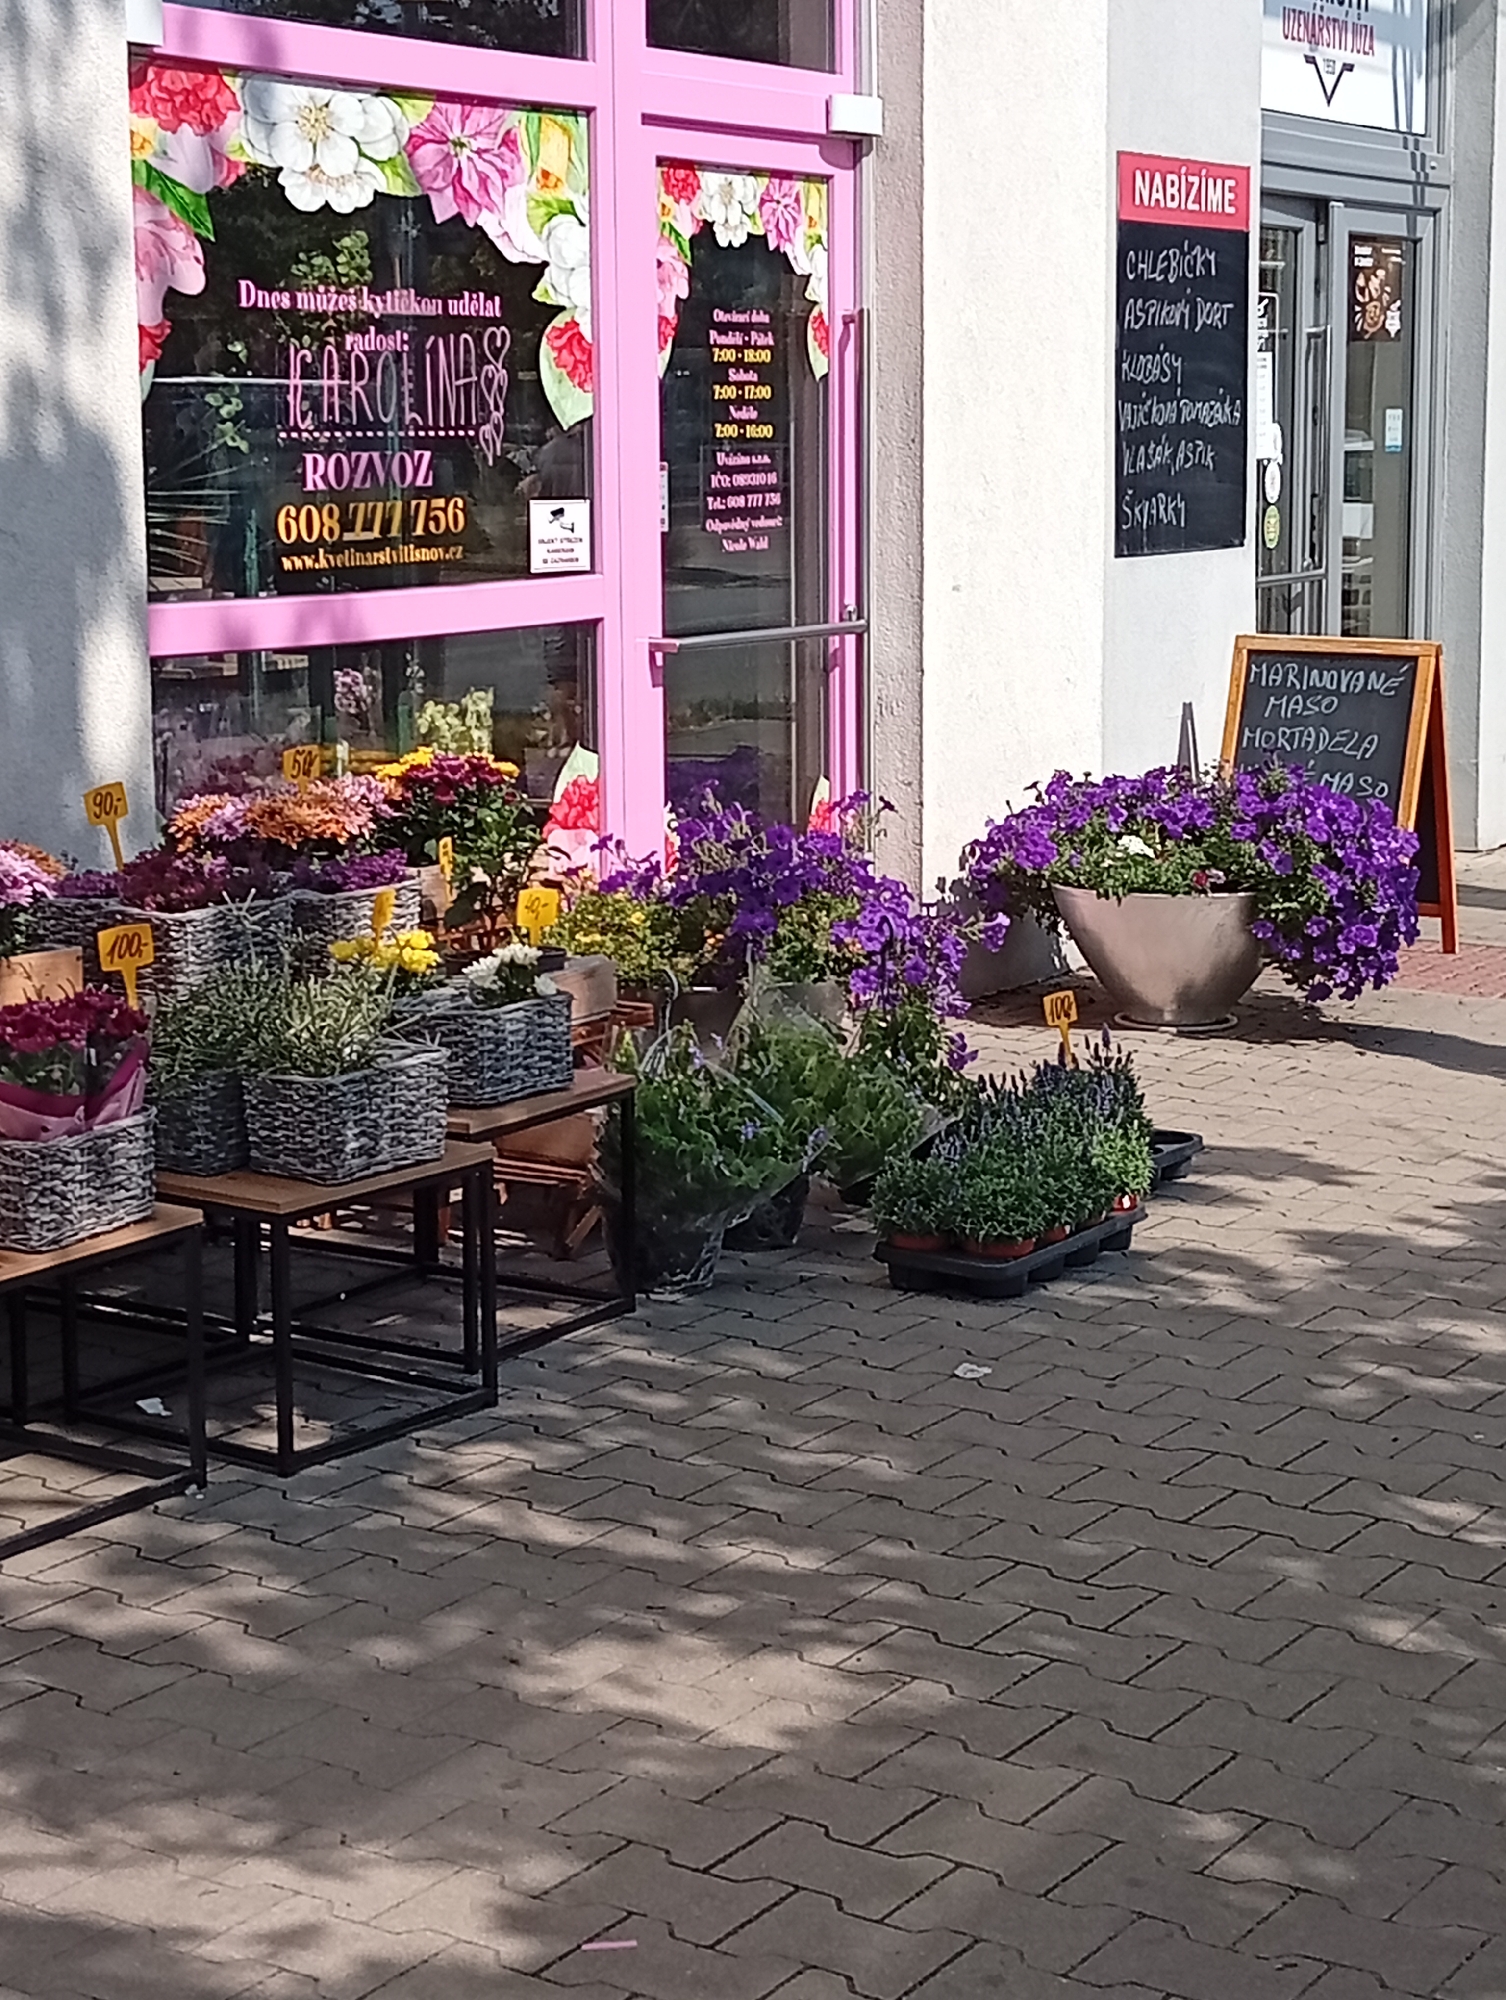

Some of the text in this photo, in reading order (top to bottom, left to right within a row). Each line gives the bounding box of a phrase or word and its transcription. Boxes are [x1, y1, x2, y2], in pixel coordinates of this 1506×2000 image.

[1135, 156, 1236, 214] NABÍZÍME
[238, 279, 291, 310] Dnes
[447, 291, 502, 318] udělat
[1194, 297, 1234, 333] DORT
[344, 326, 409, 352] radost:
[712, 347, 736, 362] 7:00
[713, 384, 737, 400] 7:00
[744, 384, 772, 400] 17:00
[302, 449, 434, 492] ROZVOZ
[1175, 439, 1215, 472] ASPIK
[277, 497, 466, 544] 608 777 756
[1121, 487, 1186, 530] ŠKVARKY
[1249, 662, 1414, 696] MARINOVANÉ
[1264, 694, 1338, 718] MASO
[1242, 726, 1379, 760] MORTADELA
[1320, 771, 1389, 799] MASO
